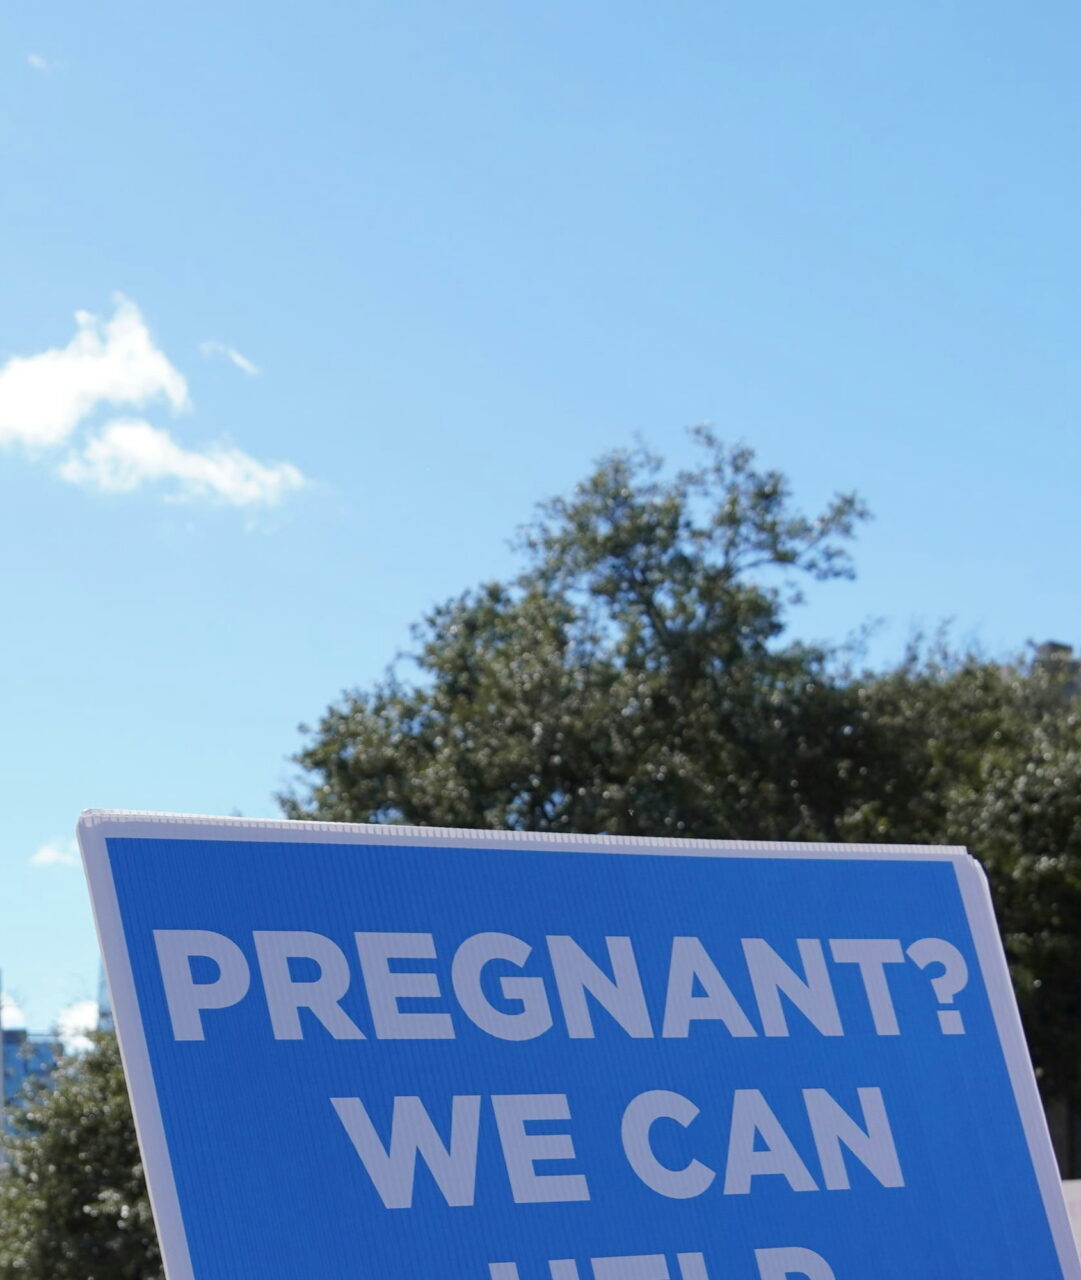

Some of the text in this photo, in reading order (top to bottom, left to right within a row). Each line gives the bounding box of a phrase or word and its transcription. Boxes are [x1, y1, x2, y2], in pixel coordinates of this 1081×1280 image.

[152, 929, 969, 1041] PREGNANT?
[331, 1087, 904, 1208] WE CAN
